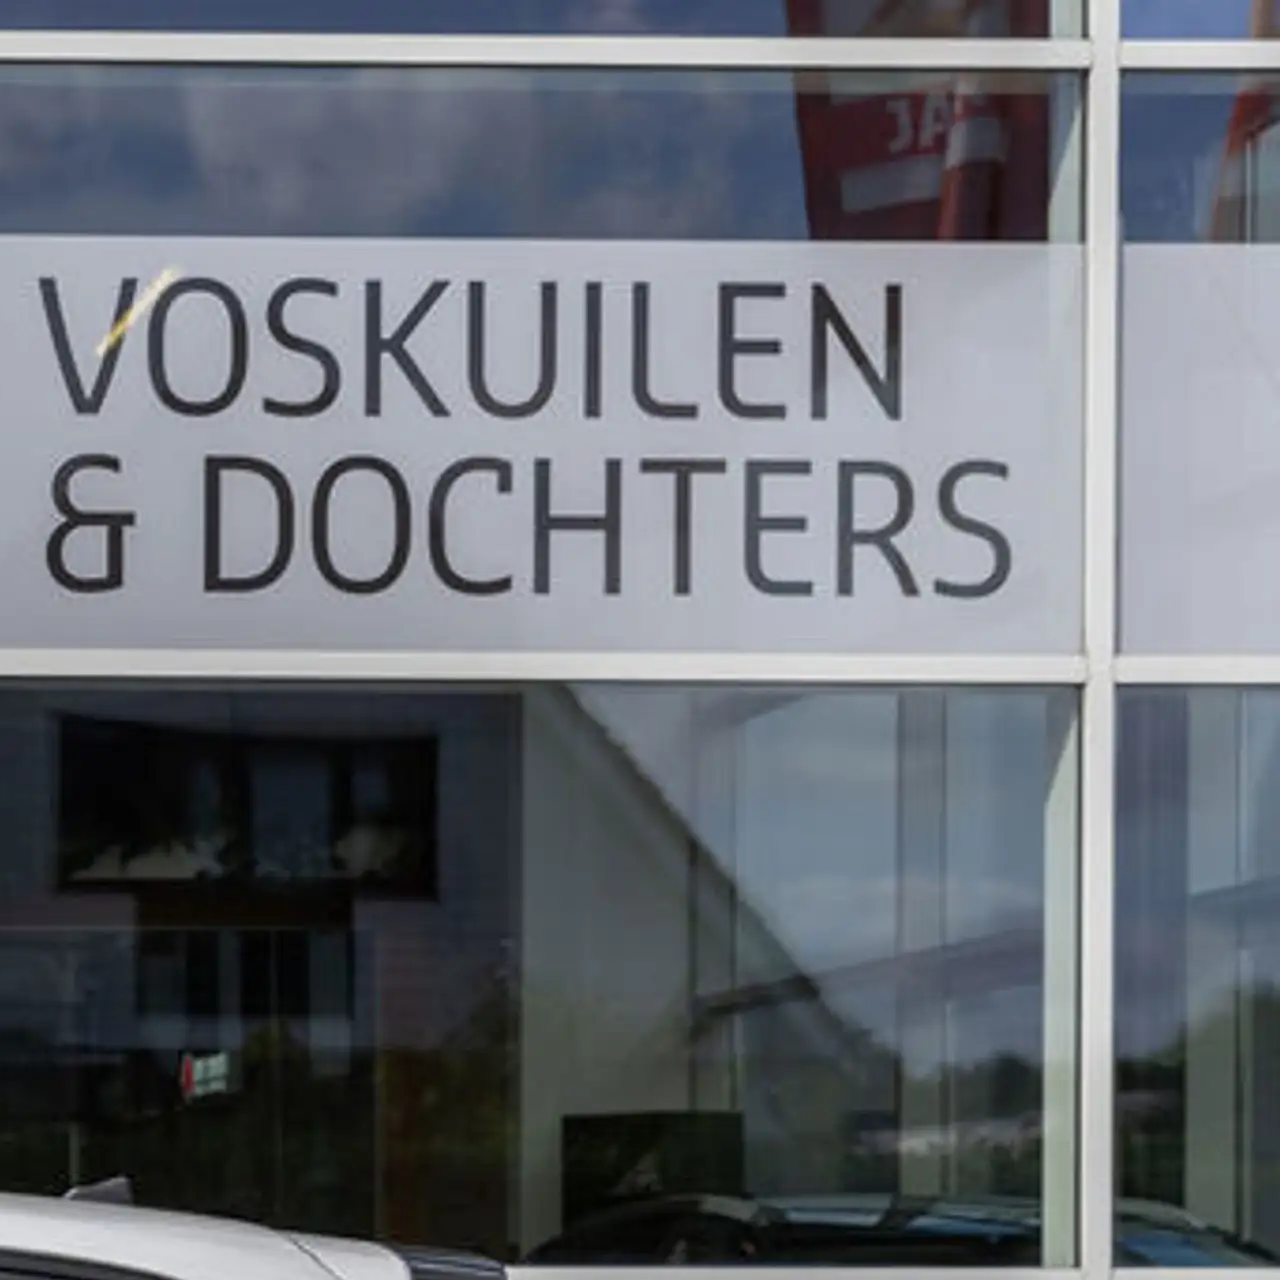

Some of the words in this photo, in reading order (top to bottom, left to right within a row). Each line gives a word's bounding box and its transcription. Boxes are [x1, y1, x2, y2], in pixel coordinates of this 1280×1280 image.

[39, 275, 904, 422] VOSKUILEN
[44, 452, 136, 593] &
[202, 454, 1012, 600] DOCHTERS
